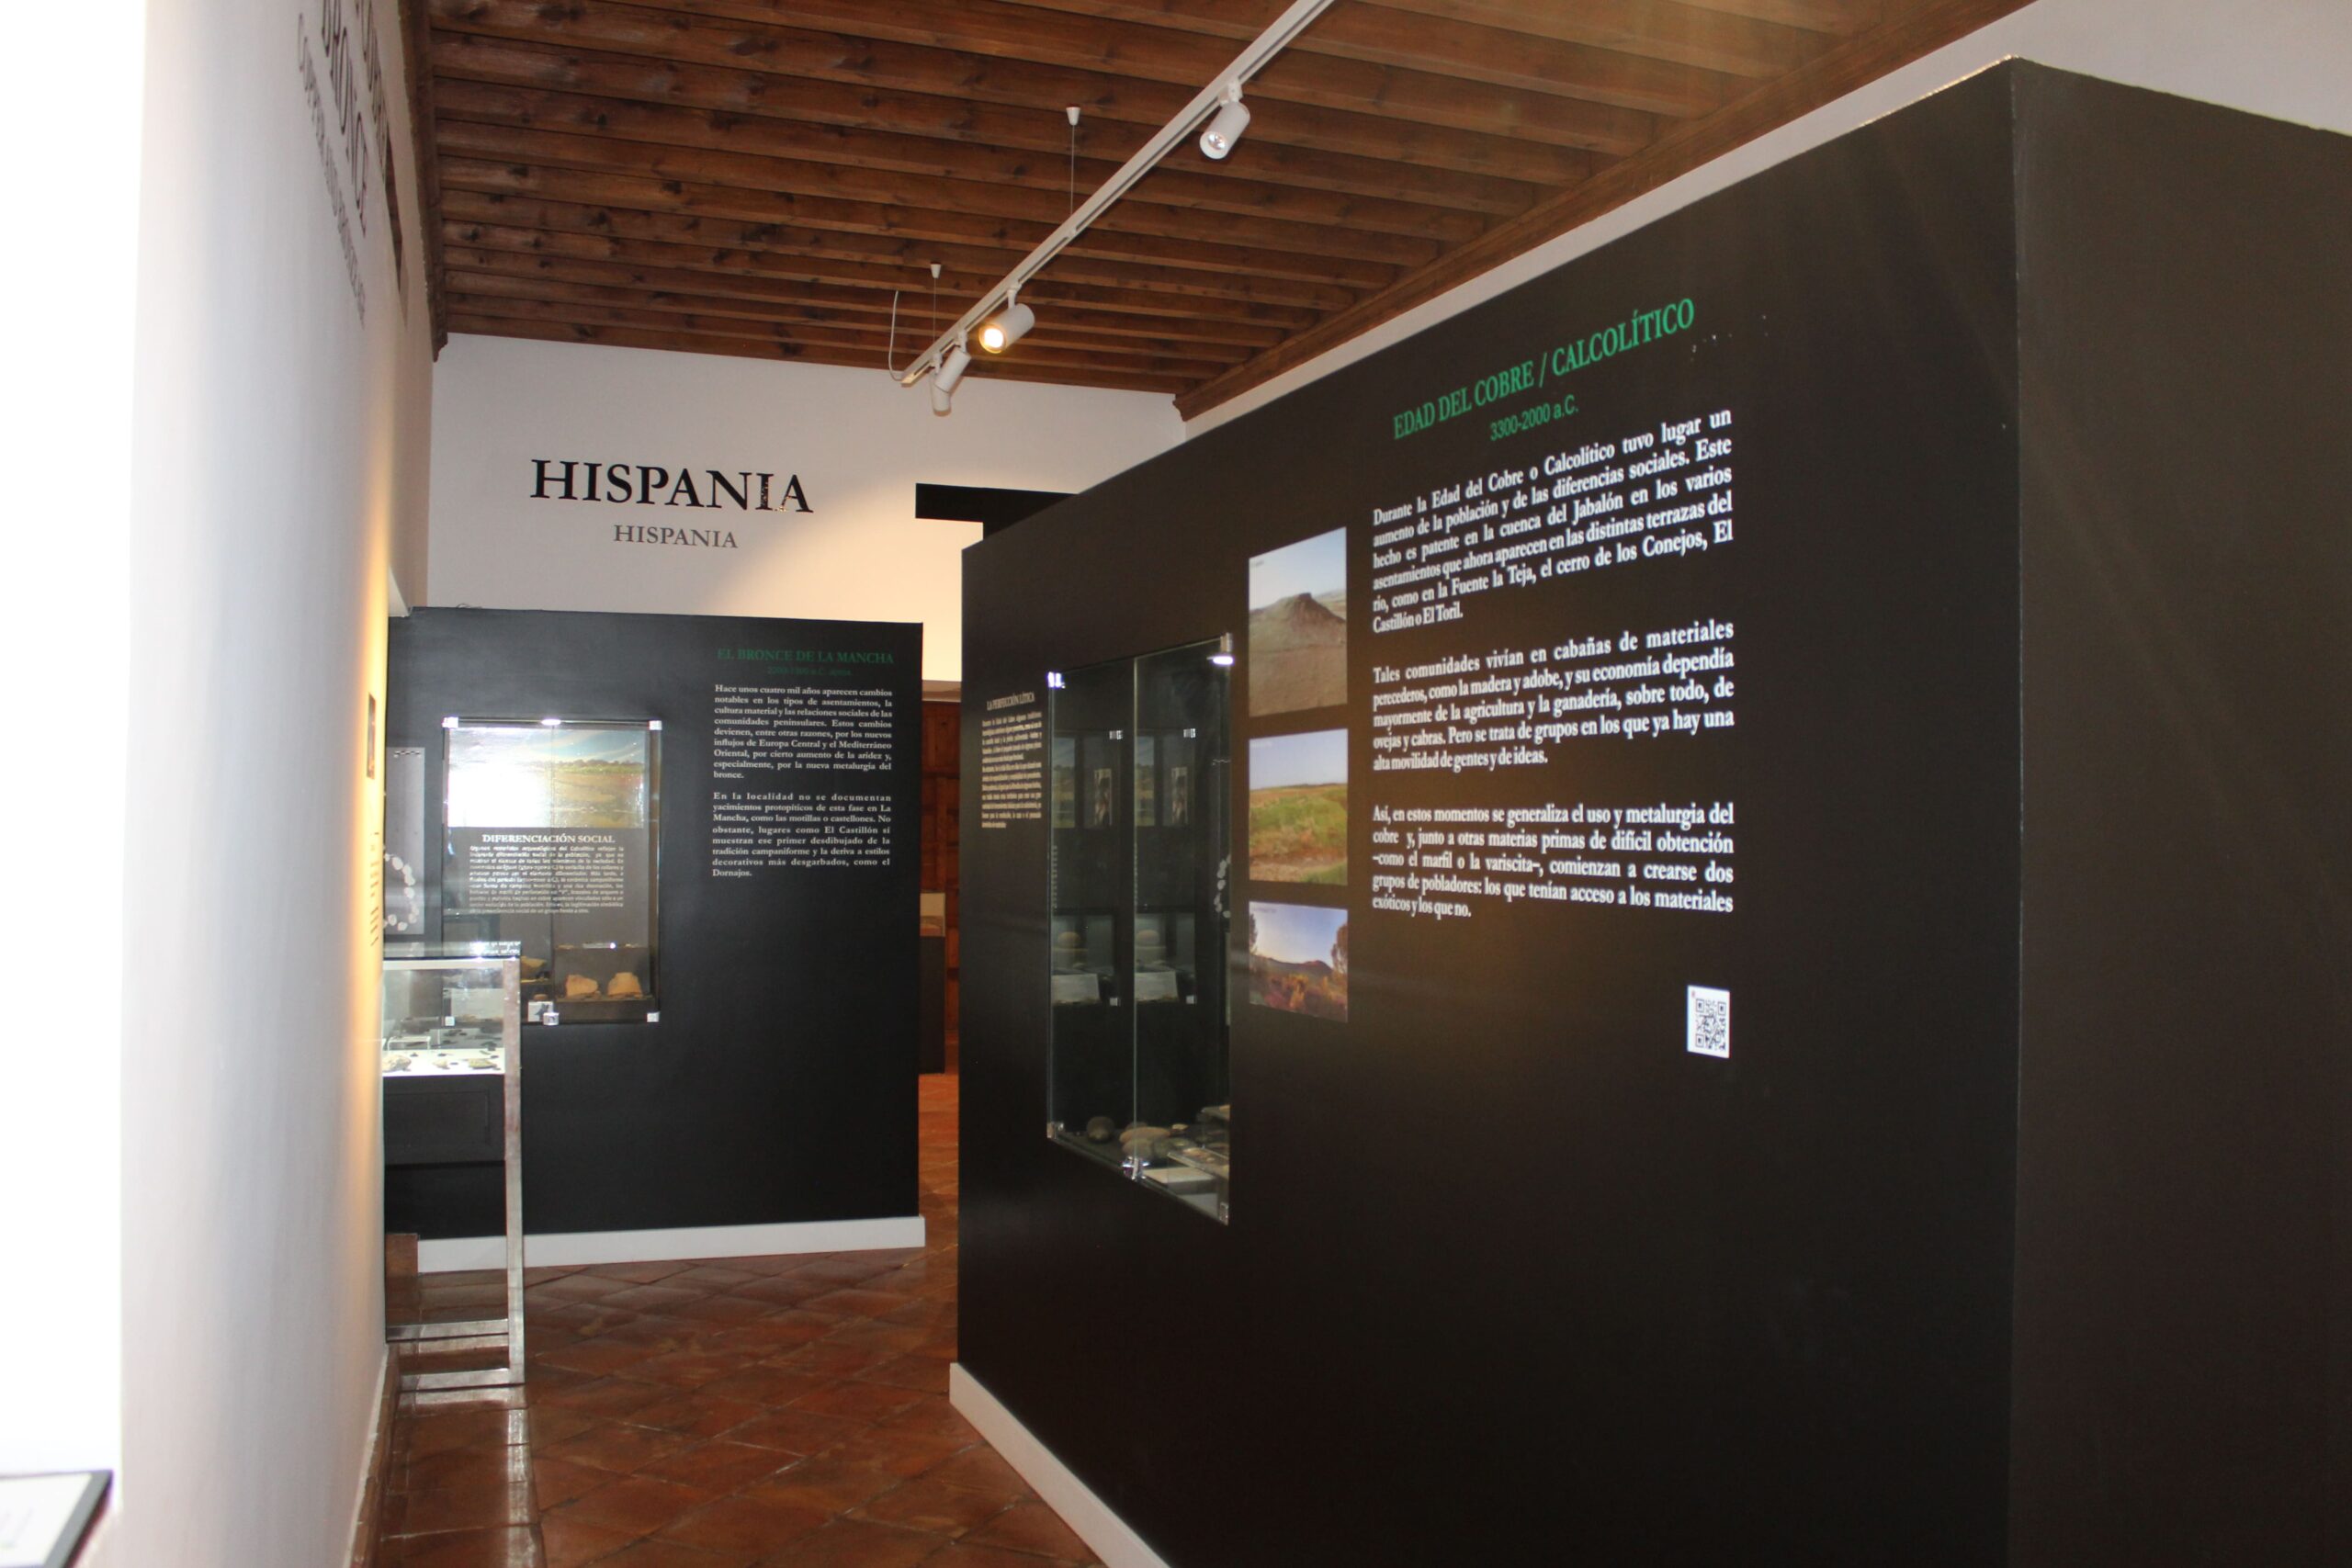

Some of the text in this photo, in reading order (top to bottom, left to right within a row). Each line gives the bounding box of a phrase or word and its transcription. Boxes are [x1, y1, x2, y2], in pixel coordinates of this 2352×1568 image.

[1393, 402, 1436, 440] EDAD
[1437, 387, 1473, 423] DEL
[1474, 360, 1535, 407] COBRE
[1551, 298, 1696, 377] CALCOLÍTICO
[1489, 393, 1579, 442] 3300-2000 a.C.
[1373, 409, 1732, 525] Durante la Edad del Cobre o Calcolítico tuvo lugar un
[530, 459, 814, 513] HISPANIA
[1373, 437, 1732, 547] aumento de la población y de las diferencias sociales. Este
[1373, 466, 1732, 568] hecho es patente en la cuenca del Jabalón en los varios
[614, 525, 739, 548] HISPANIA
[1373, 489, 1733, 590] asentamientos que ahora aparecen en las distintas terrazas del
[1373, 518, 1733, 613] río, como en la Fuente la Teja, el cerro de los Conejos, El
[1372, 600, 1464, 633] Castillón o El Toril.
[717, 648, 895, 664] EL BRONCE DE LA MANCHA
[1374, 618, 1734, 683] Tales comunidades vivían en cabañas de materiales
[714, 683, 737, 693] Hace
[801, 686, 820, 694] años
[821, 689, 858, 697] aparecen
[858, 688, 892, 696] cambios
[714, 694, 749, 704] notables
[766, 695, 779, 704] los
[783, 697, 803, 707] tipos
[713, 738, 744, 748] influjos
[758, 739, 789, 749] Europa
[790, 739, 820, 748] Central
[713, 748, 750, 759] Oriental,
[752, 750, 767, 760] por
[769, 750, 794, 758] cierto
[857, 750, 882, 759] aridez
[746, 792, 793, 800] localidad
[712, 813, 749, 822] Mancha,
[775, 813, 786, 821] las
[1373, 801, 1735, 830] Así, en estos momentos se generaliza el uso y metalurgia del
[482, 833, 616, 843] DIFERENCIACIÓN SOCIAL
[711, 825, 753, 834] obstante,
[758, 825, 791, 836] lugares
[838, 825, 878, 833] Castillón
[1373, 827, 1734, 854] cobre y, junto a otras materias primas de difícil obtención
